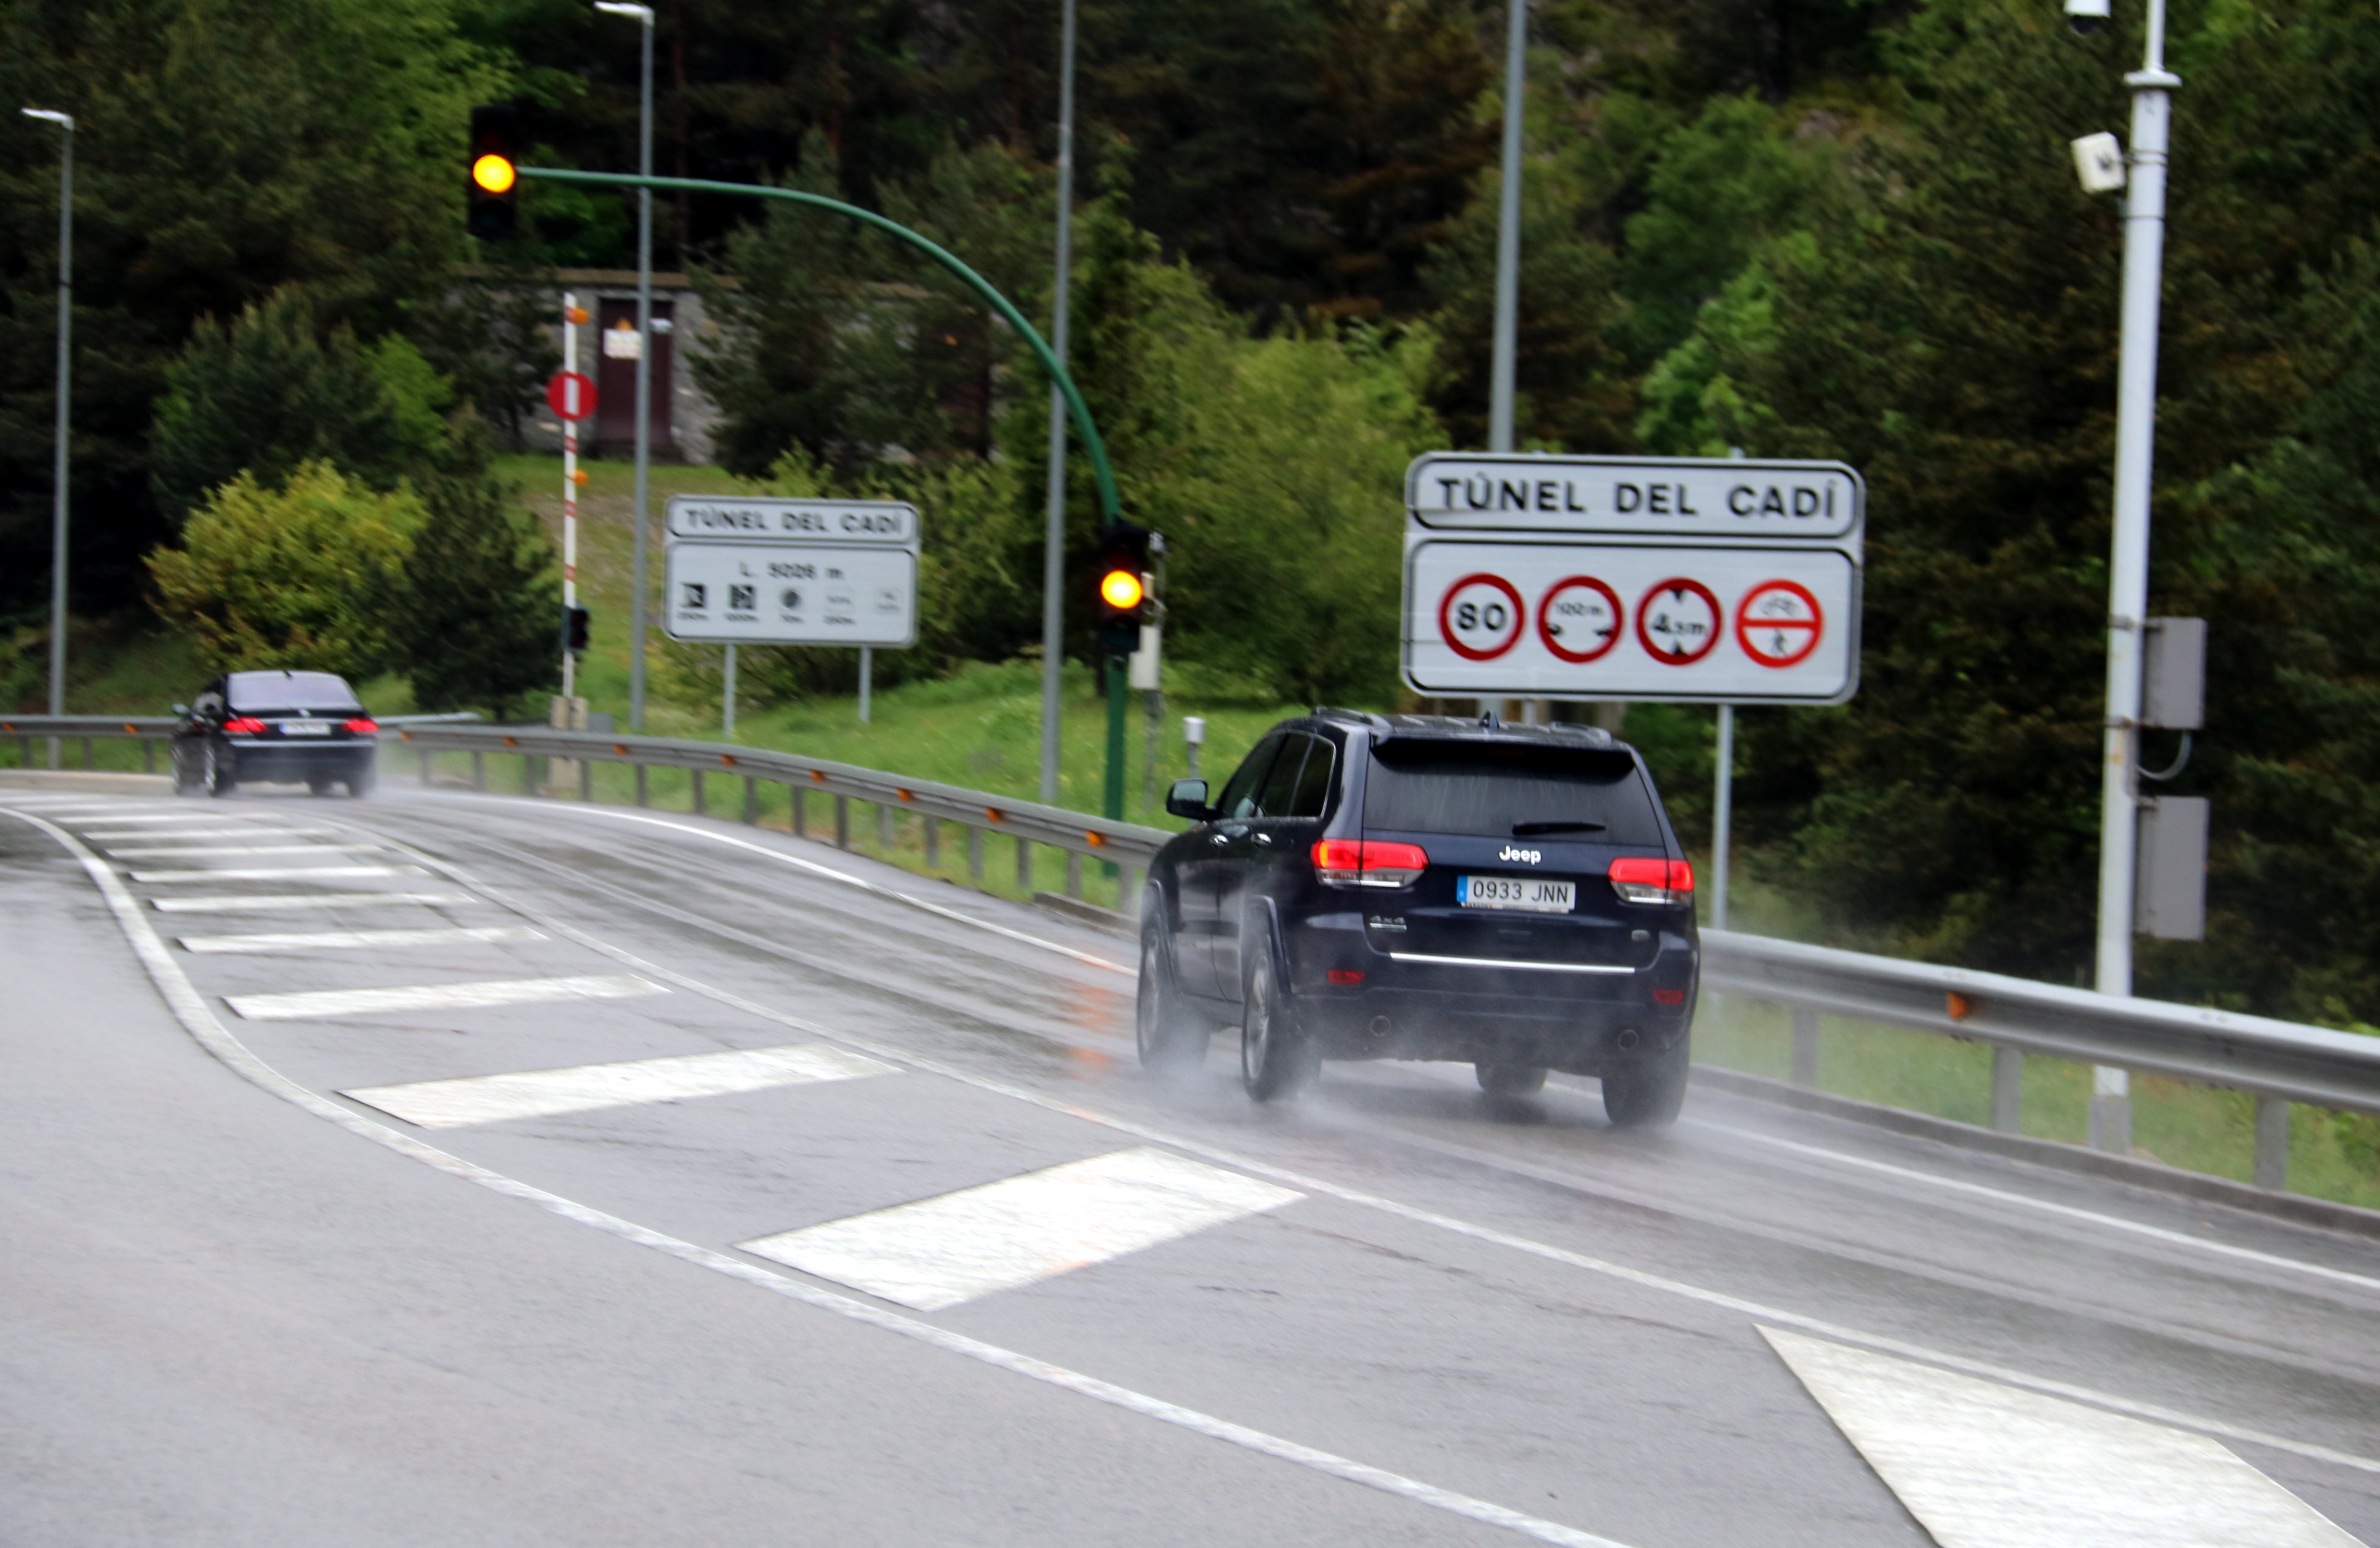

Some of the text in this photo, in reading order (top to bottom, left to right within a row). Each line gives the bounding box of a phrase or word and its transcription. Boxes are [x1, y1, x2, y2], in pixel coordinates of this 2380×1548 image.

[1613, 482, 1698, 516] DEL
[1727, 480, 1840, 519] CADÍ
[781, 512, 829, 533] DEL
[1455, 602, 1506, 632] 80
[1499, 845, 1542, 865] Jeep
[1474, 880, 1568, 903] 0933 JNN
